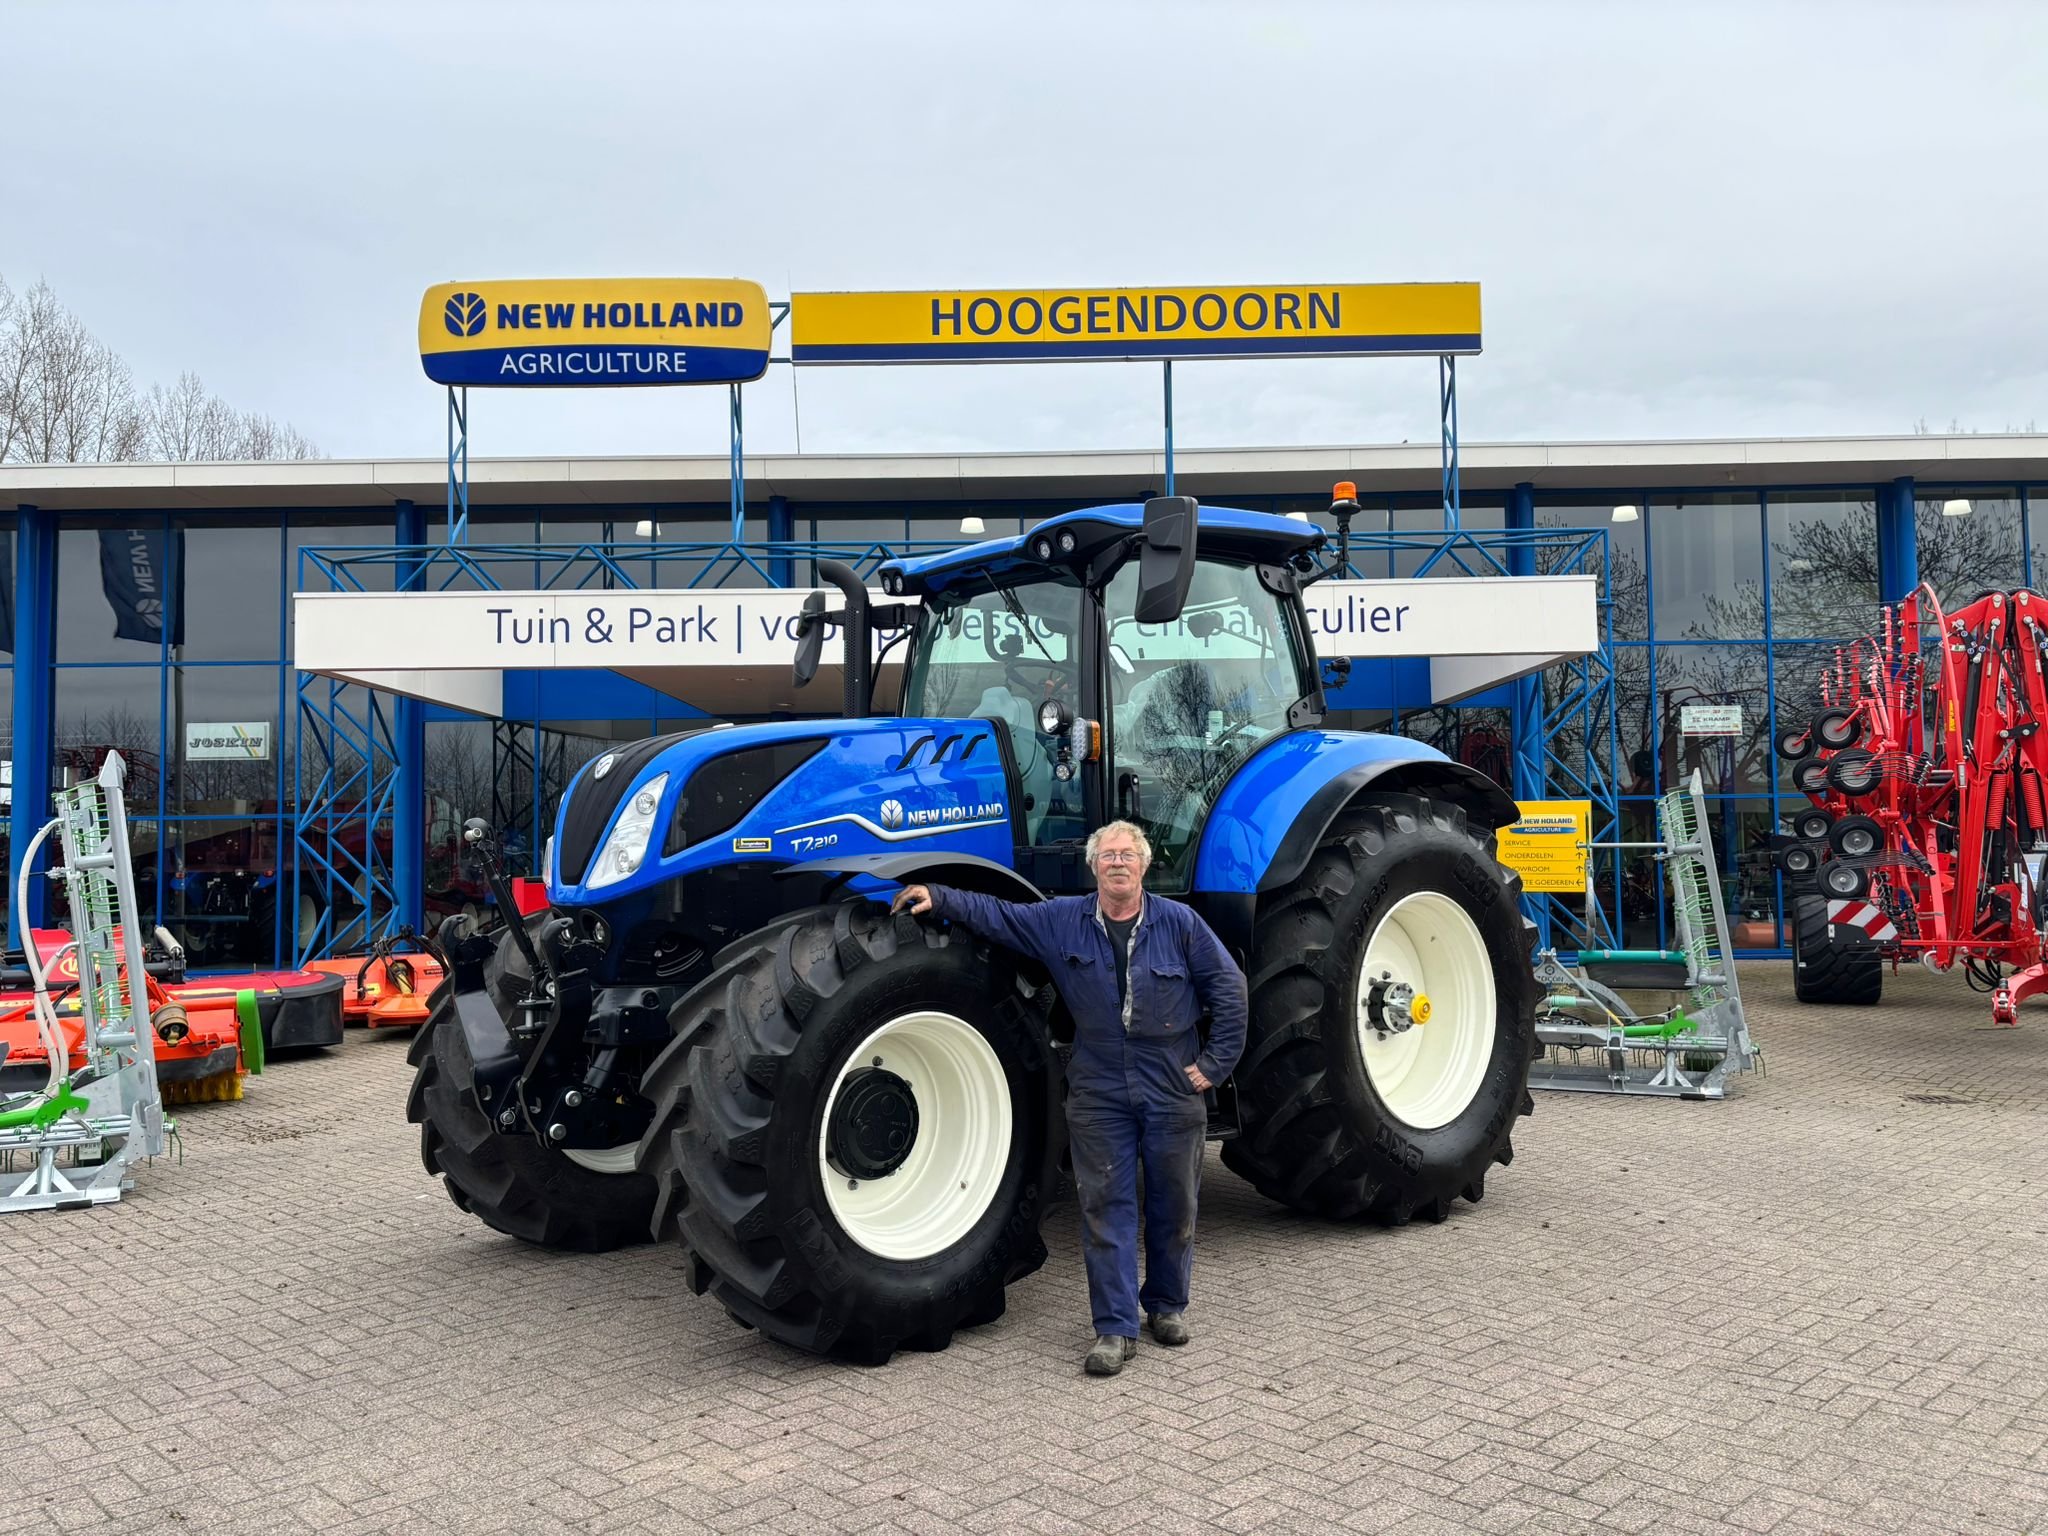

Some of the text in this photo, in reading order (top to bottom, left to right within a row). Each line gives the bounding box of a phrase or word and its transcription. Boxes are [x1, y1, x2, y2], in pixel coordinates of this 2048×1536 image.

[497, 302, 744, 330] NEW HOLLAND
[931, 291, 1341, 336] HOOGENDOORN
[500, 351, 687, 375] AGRICULTURE
[486, 607, 570, 644] Tuin
[584, 607, 614, 644] &
[628, 605, 718, 644] Park
[188, 737, 263, 749] JOSKIN
[908, 802, 1004, 827] NEW HOLLAND
[790, 834, 838, 854] T7.210
